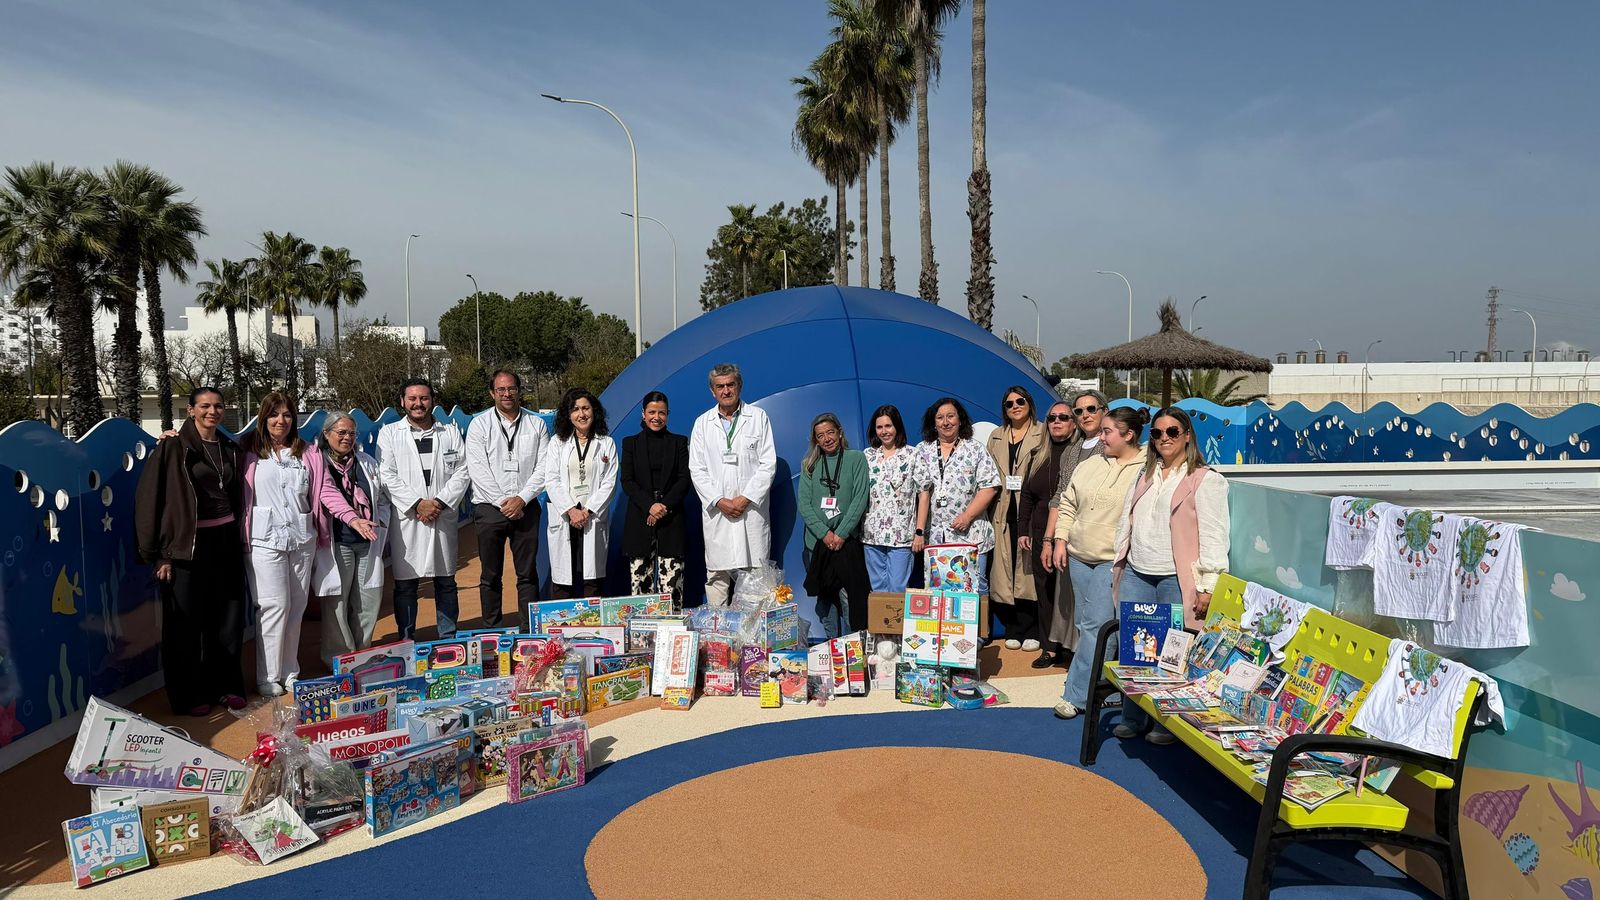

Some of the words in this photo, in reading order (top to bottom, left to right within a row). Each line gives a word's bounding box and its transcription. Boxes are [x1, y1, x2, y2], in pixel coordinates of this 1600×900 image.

[592, 676, 629, 691] TANGRAM
[1289, 674, 1319, 696] PALABRAS
[300, 685, 341, 701] CONNECT
[126, 734, 165, 745] SCOOTER
[313, 726, 366, 744] Juegos
[124, 743, 140, 752] LED
[102, 812, 137, 826] Abecedario
[90, 832, 102, 846] A
